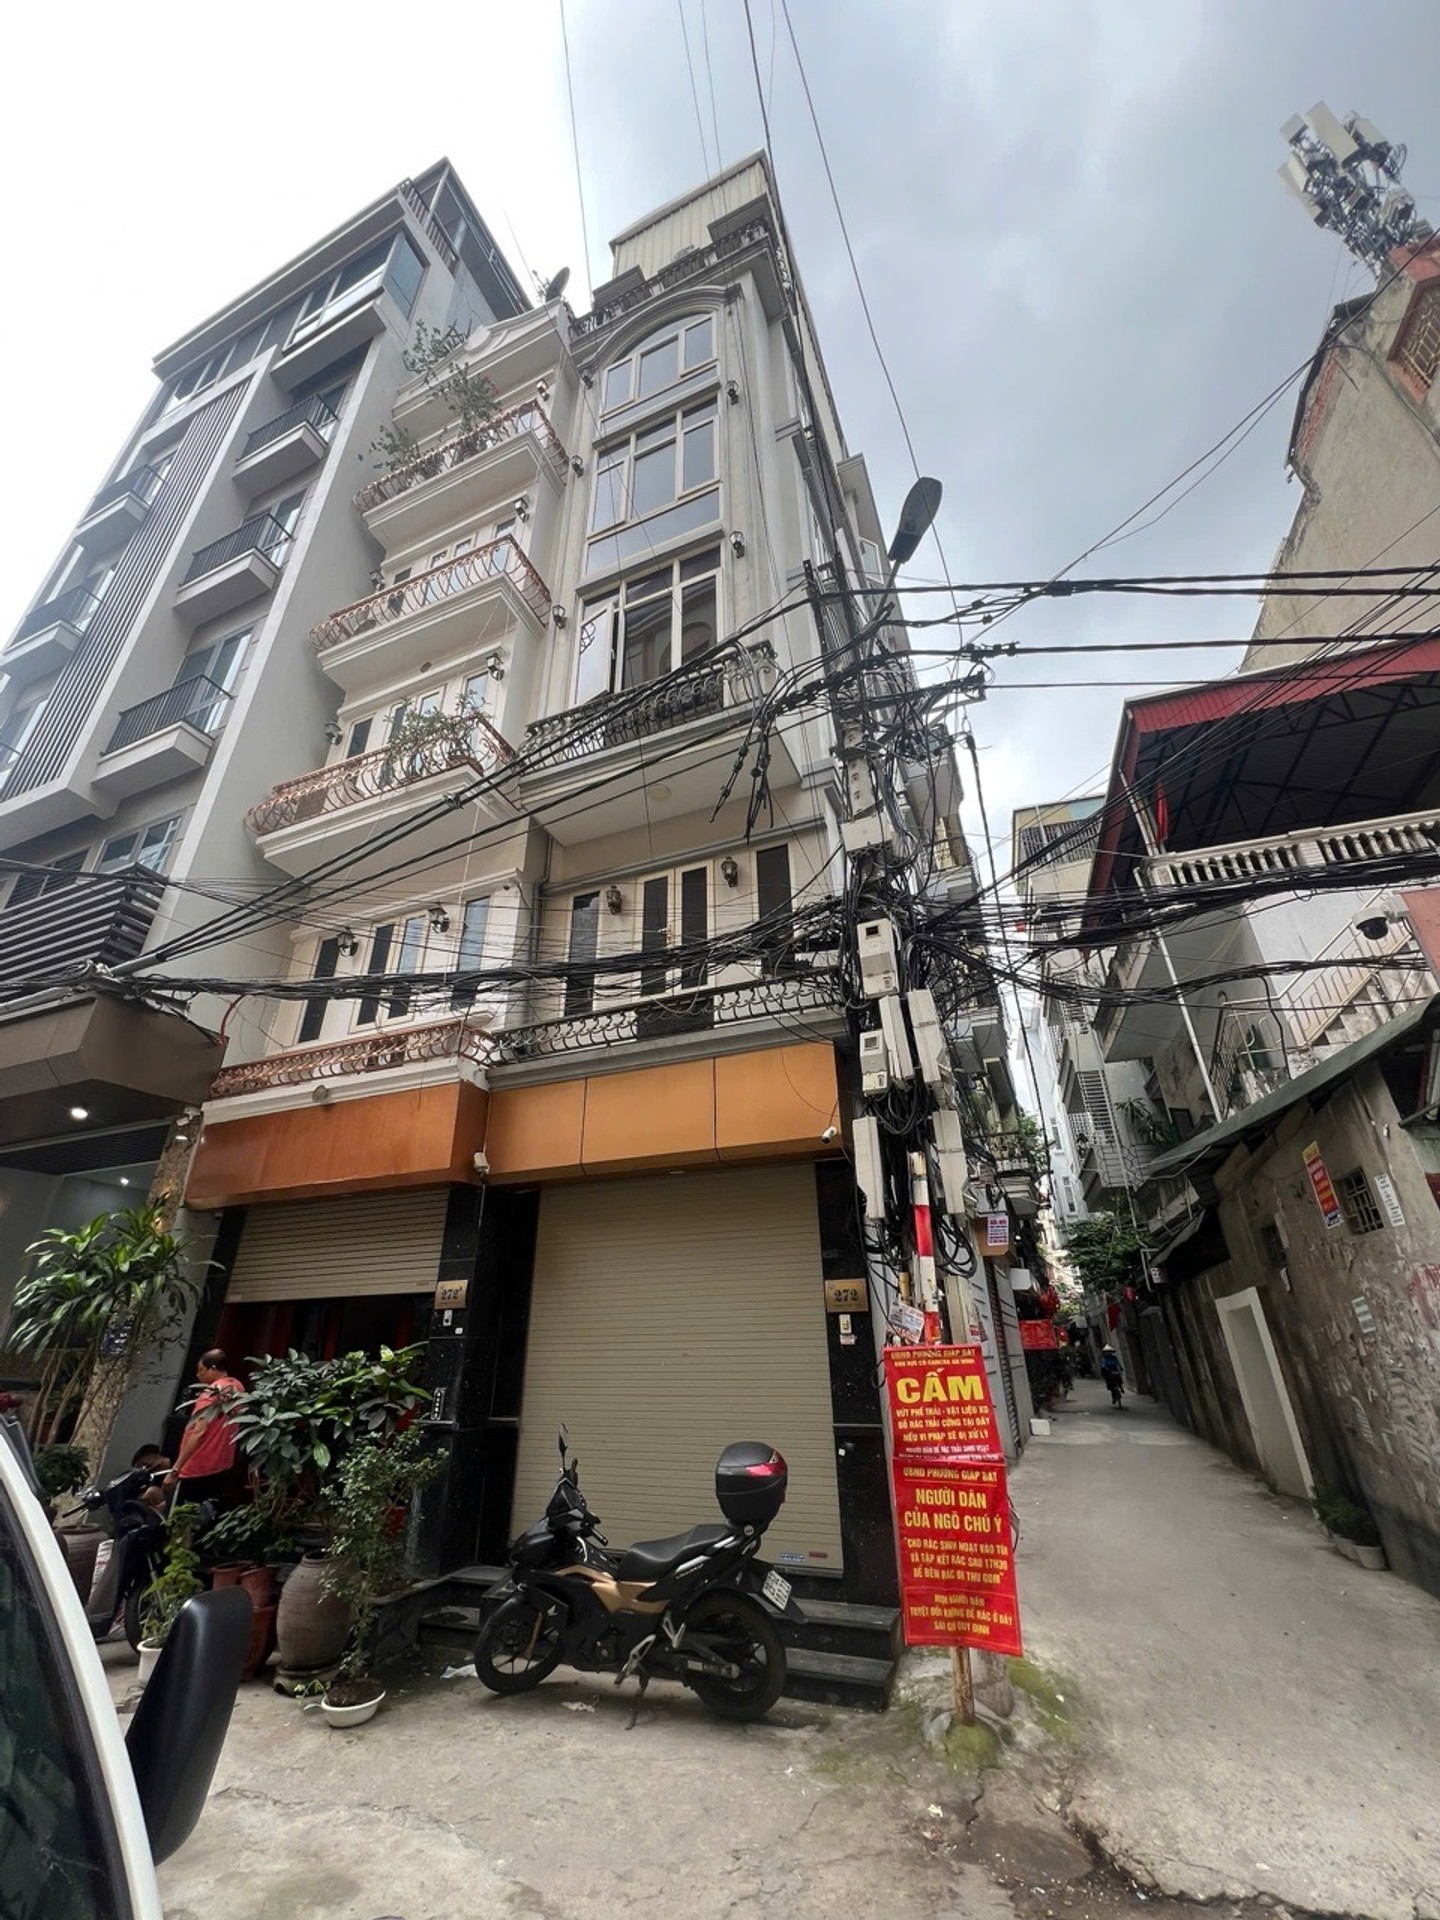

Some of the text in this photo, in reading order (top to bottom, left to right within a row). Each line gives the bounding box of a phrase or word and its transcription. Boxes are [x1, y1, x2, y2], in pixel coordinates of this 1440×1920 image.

[833, 1288, 858, 1302] 272
[896, 1368, 984, 1404] CẤM
[910, 1406, 925, 1417] PHẾ
[925, 1405, 941, 1416] THẢI
[946, 1405, 960, 1416] VẬT
[961, 1405, 978, 1416] LIỆU
[909, 1419, 924, 1428] RÁC
[925, 1416, 940, 1428] THẢI
[962, 1418, 974, 1427] TẠI
[975, 1416, 990, 1426] ĐÂY
[903, 1431, 918, 1442] NẾU
[920, 1432, 927, 1441] VI
[947, 1429, 958, 1440] SẼ
[915, 1486, 987, 1509] NGƯỜI DÂN
[904, 1506, 1002, 1533] CỦA NGÕ CHÚ Ý
[923, 1539, 938, 1549] RÁC
[940, 1540, 957, 1551] SINH
[958, 1541, 978, 1555] HOẠT
[979, 1543, 994, 1554] VÀO
[910, 1552, 919, 1562] VÀ
[921, 1553, 935, 1565] TẬP
[936, 1553, 950, 1565] KẾT
[951, 1555, 966, 1566] RÁC
[968, 1557, 983, 1568] SAU
[910, 1604, 929, 1617] TUYỆT
[943, 1606, 964, 1618] KHÔNG
[976, 1609, 991, 1622] RÁC
[999, 1613, 1013, 1626] ĐÂY
[934, 1621, 946, 1631] SAI
